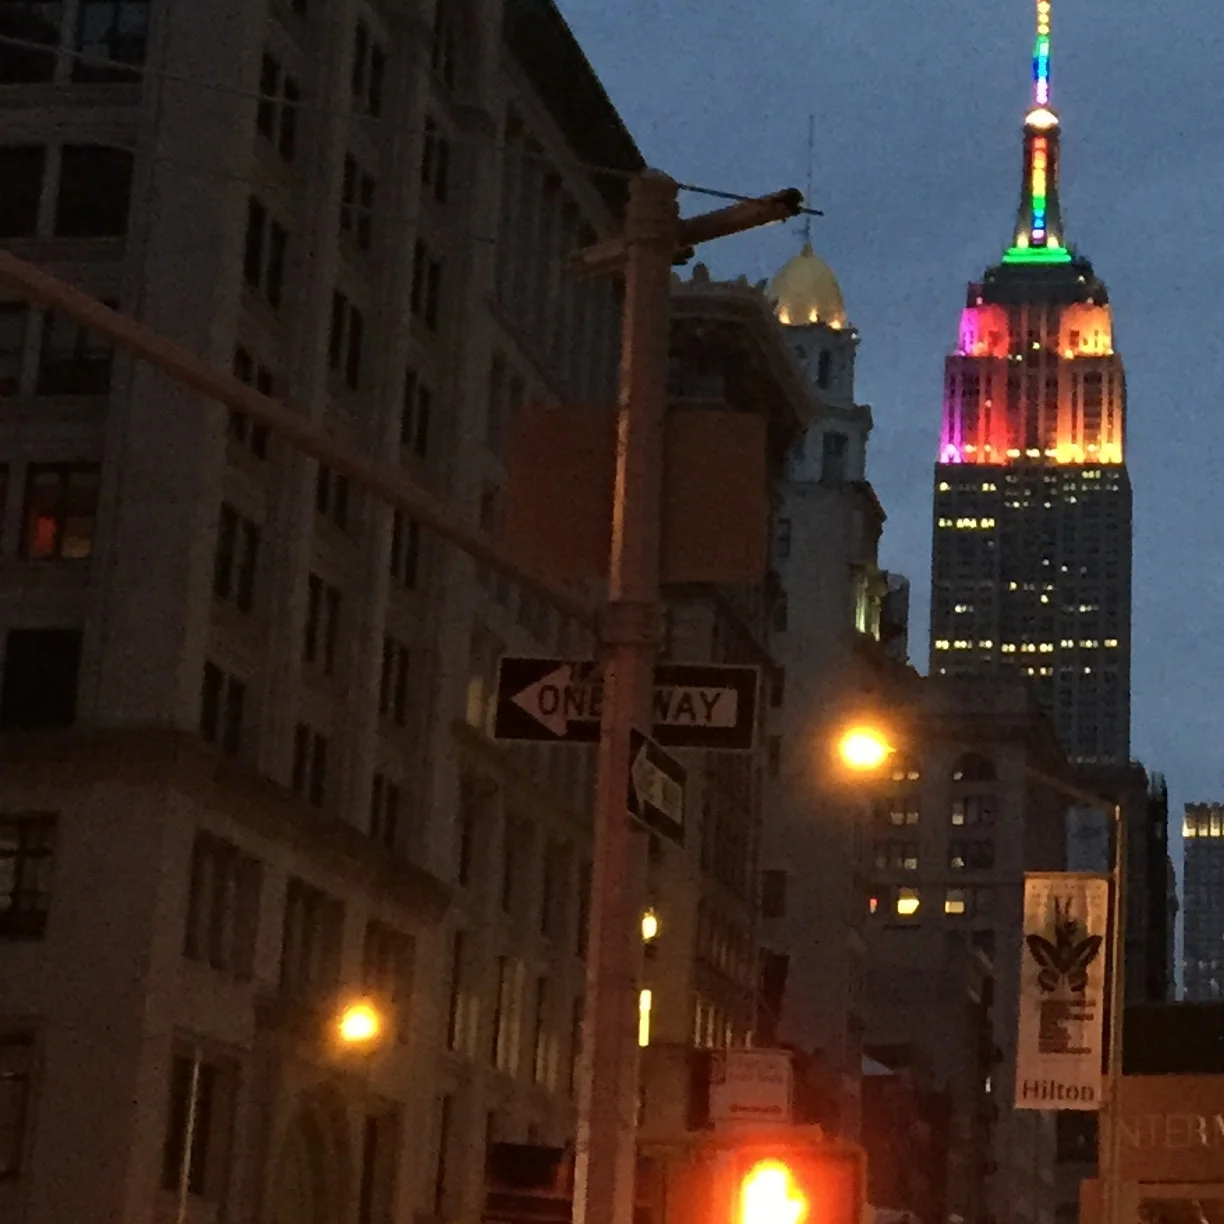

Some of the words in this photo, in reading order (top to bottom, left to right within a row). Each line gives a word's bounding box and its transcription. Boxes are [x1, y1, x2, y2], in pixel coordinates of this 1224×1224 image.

[538, 684, 601, 718] ONE
[652, 687, 721, 723] WAY
[1022, 1079, 1094, 1101] Hilton
